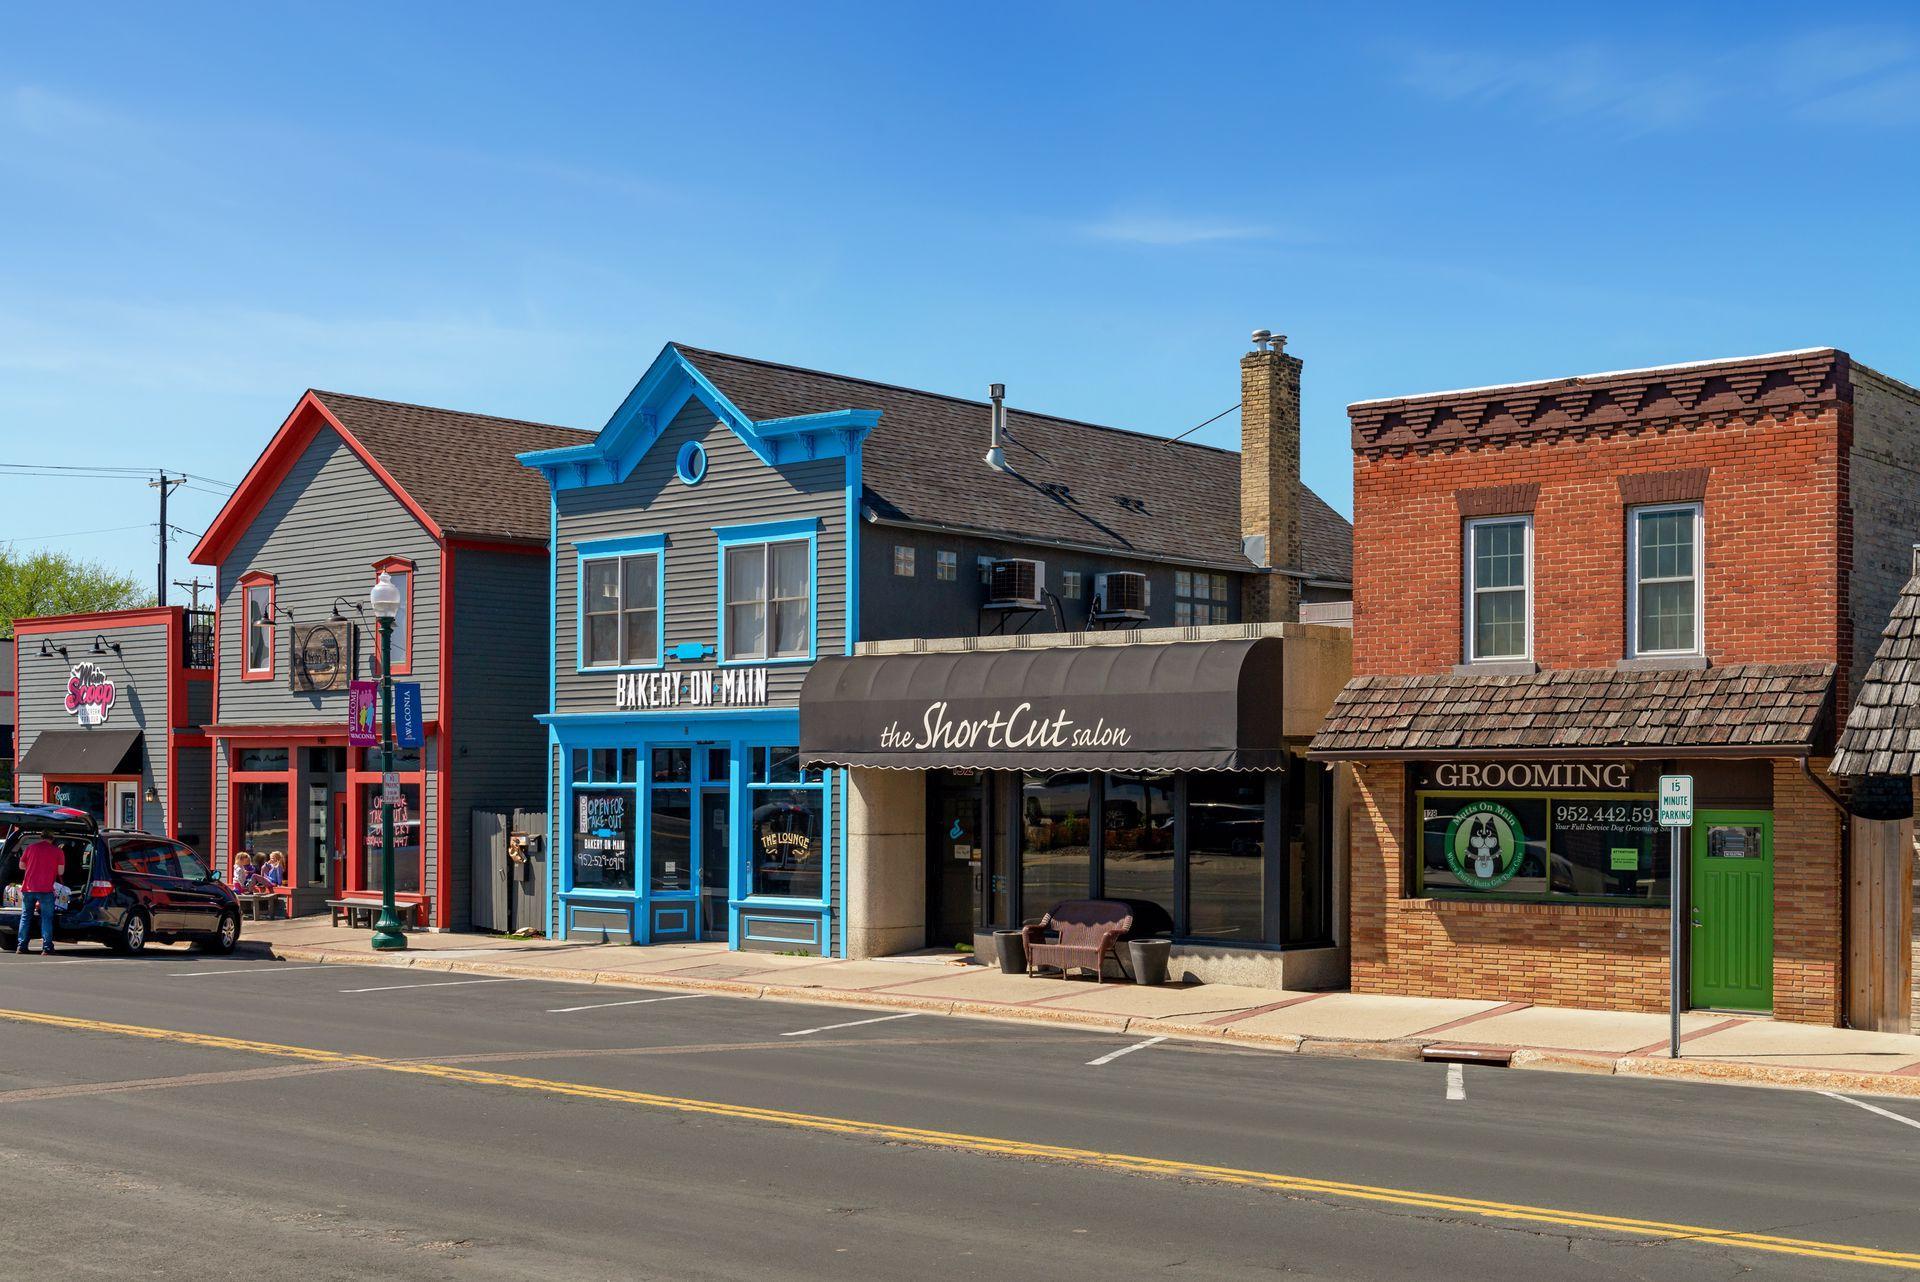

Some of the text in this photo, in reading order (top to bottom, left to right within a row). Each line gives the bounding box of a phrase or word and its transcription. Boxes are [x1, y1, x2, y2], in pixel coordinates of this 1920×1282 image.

[616, 668, 767, 707] BAKERY ON MAIN
[66, 677, 113, 717] Scoop
[404, 690, 413, 735] WACONIA
[880, 701, 1131, 749] the ShortCut salon
[1435, 763, 1630, 788] GROOMING
[1671, 782, 1681, 792] 15
[588, 797, 624, 815] OPEN FOR
[1663, 796, 1688, 806] MINUTE
[1424, 809, 1438, 818] 128
[1453, 802, 1516, 826] Mutts On Main
[1661, 810, 1691, 820] PARKING
[1555, 823, 1570, 831] Your
[1571, 823, 1584, 831] Full
[1586, 823, 1609, 831] Service
[1611, 824, 1624, 832] Dog
[1625, 825, 1658, 833] Grooming
[584, 839, 603, 850] BAKERY
[761, 832, 810, 849] THE LOUNGE
